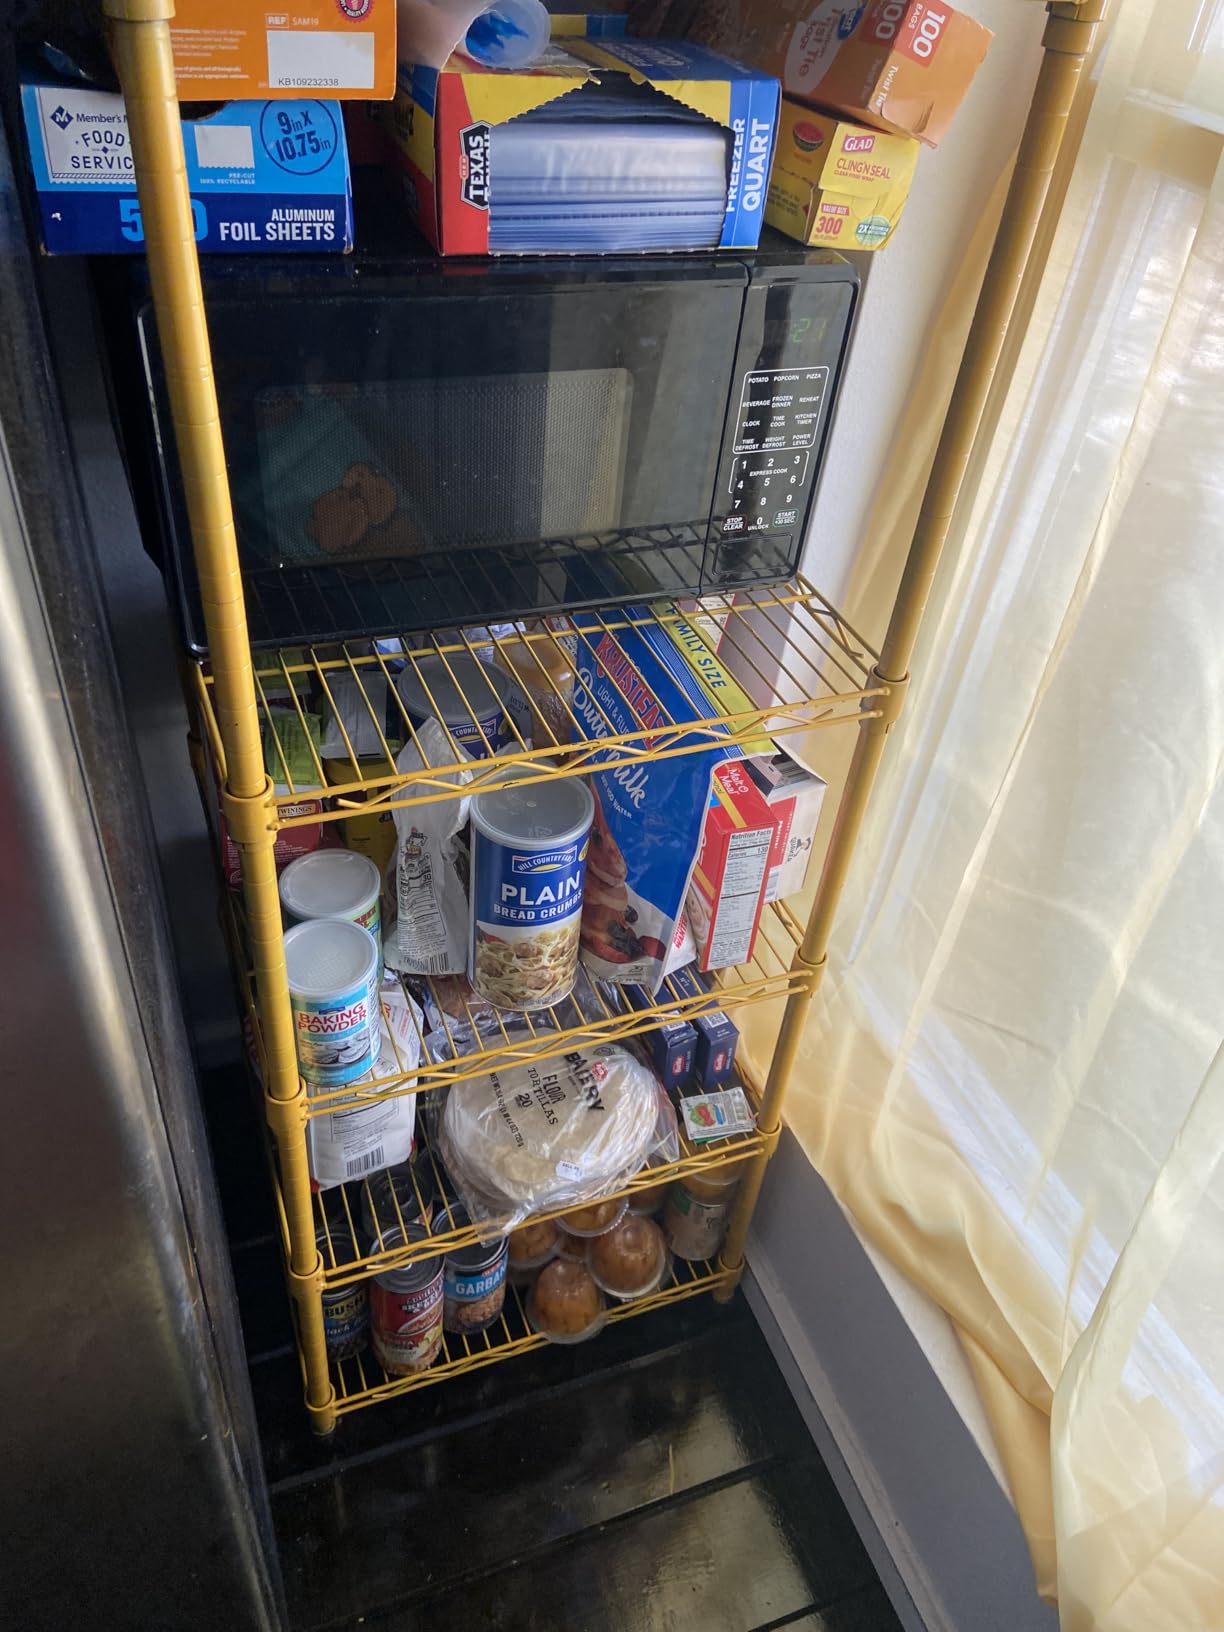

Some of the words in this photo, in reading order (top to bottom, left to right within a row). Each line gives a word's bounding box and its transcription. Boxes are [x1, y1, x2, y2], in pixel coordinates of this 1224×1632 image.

[292, 17, 319, 26] SAM19
[908, 3, 923, 29] BAGS
[913, 9, 945, 58] 100
[278, 78, 339, 87] KB109232338
[76, 113, 122, 124] Member's
[81, 130, 125, 147] FOOD
[844, 136, 873, 152] GLAD
[71, 156, 133, 170] SERVIC
[469, 135, 484, 201] TEXAS
[726, 118, 745, 212] FREEZER
[742, 118, 770, 212] QUART
[870, 165, 891, 179] SEAL
[119, 200, 208, 242] 50
[271, 209, 335, 221] ALUMINUM
[220, 222, 261, 241] FOIL
[265, 223, 335, 241] SHEETS
[816, 216, 843, 235] 300
[742, 400, 770, 408] BEVERAGE
[742, 461, 747, 470] 1
[767, 458, 774, 467] 2
[793, 455, 800, 464] 3
[737, 480, 744, 489] 4
[763, 478, 770, 487] 5
[790, 475, 796, 484] 6
[734, 500, 741, 509] 7
[760, 497, 767, 506] 8
[786, 494, 792, 503] 9
[756, 516, 763, 525] 0
[697, 658, 727, 689] SIZE
[728, 768, 745, 787] Malt
[731, 831, 756, 840] Nutrition
[756, 829, 771, 837] Facts
[517, 860, 533, 872] HILL
[533, 855, 561, 867] COUNTRY
[501, 870, 580, 906] PLAIN
[493, 903, 536, 920] BREAD
[540, 888, 582, 919] CRUMBS
[298, 1009, 367, 1033] POWDER
[299, 1002, 365, 1025] BAKING
[518, 1092, 533, 1108] 20
[527, 1067, 559, 1126] TORTILLAS
